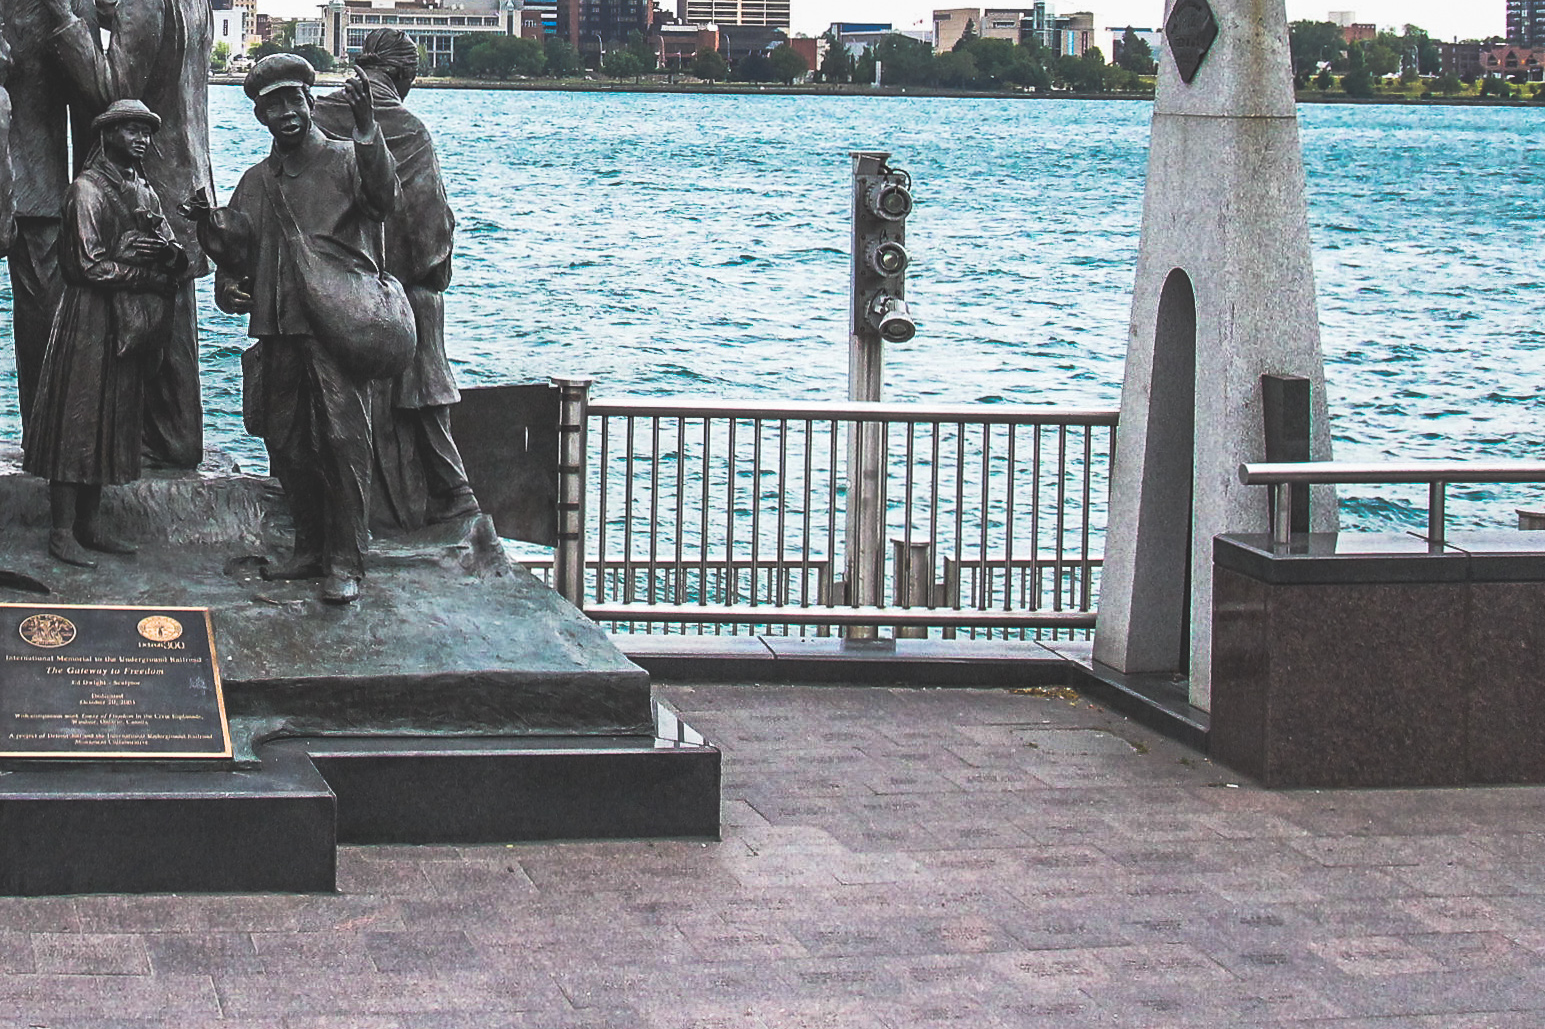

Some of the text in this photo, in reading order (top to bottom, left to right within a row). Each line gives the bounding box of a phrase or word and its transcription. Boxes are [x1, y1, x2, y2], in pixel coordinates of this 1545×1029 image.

[5, 654, 54, 662] International
[119, 655, 167, 664] Underground
[46, 666, 164, 676] The Gateway to Freedom
[82, 679, 106, 687] Dwight
[113, 679, 140, 687] Sculptor
